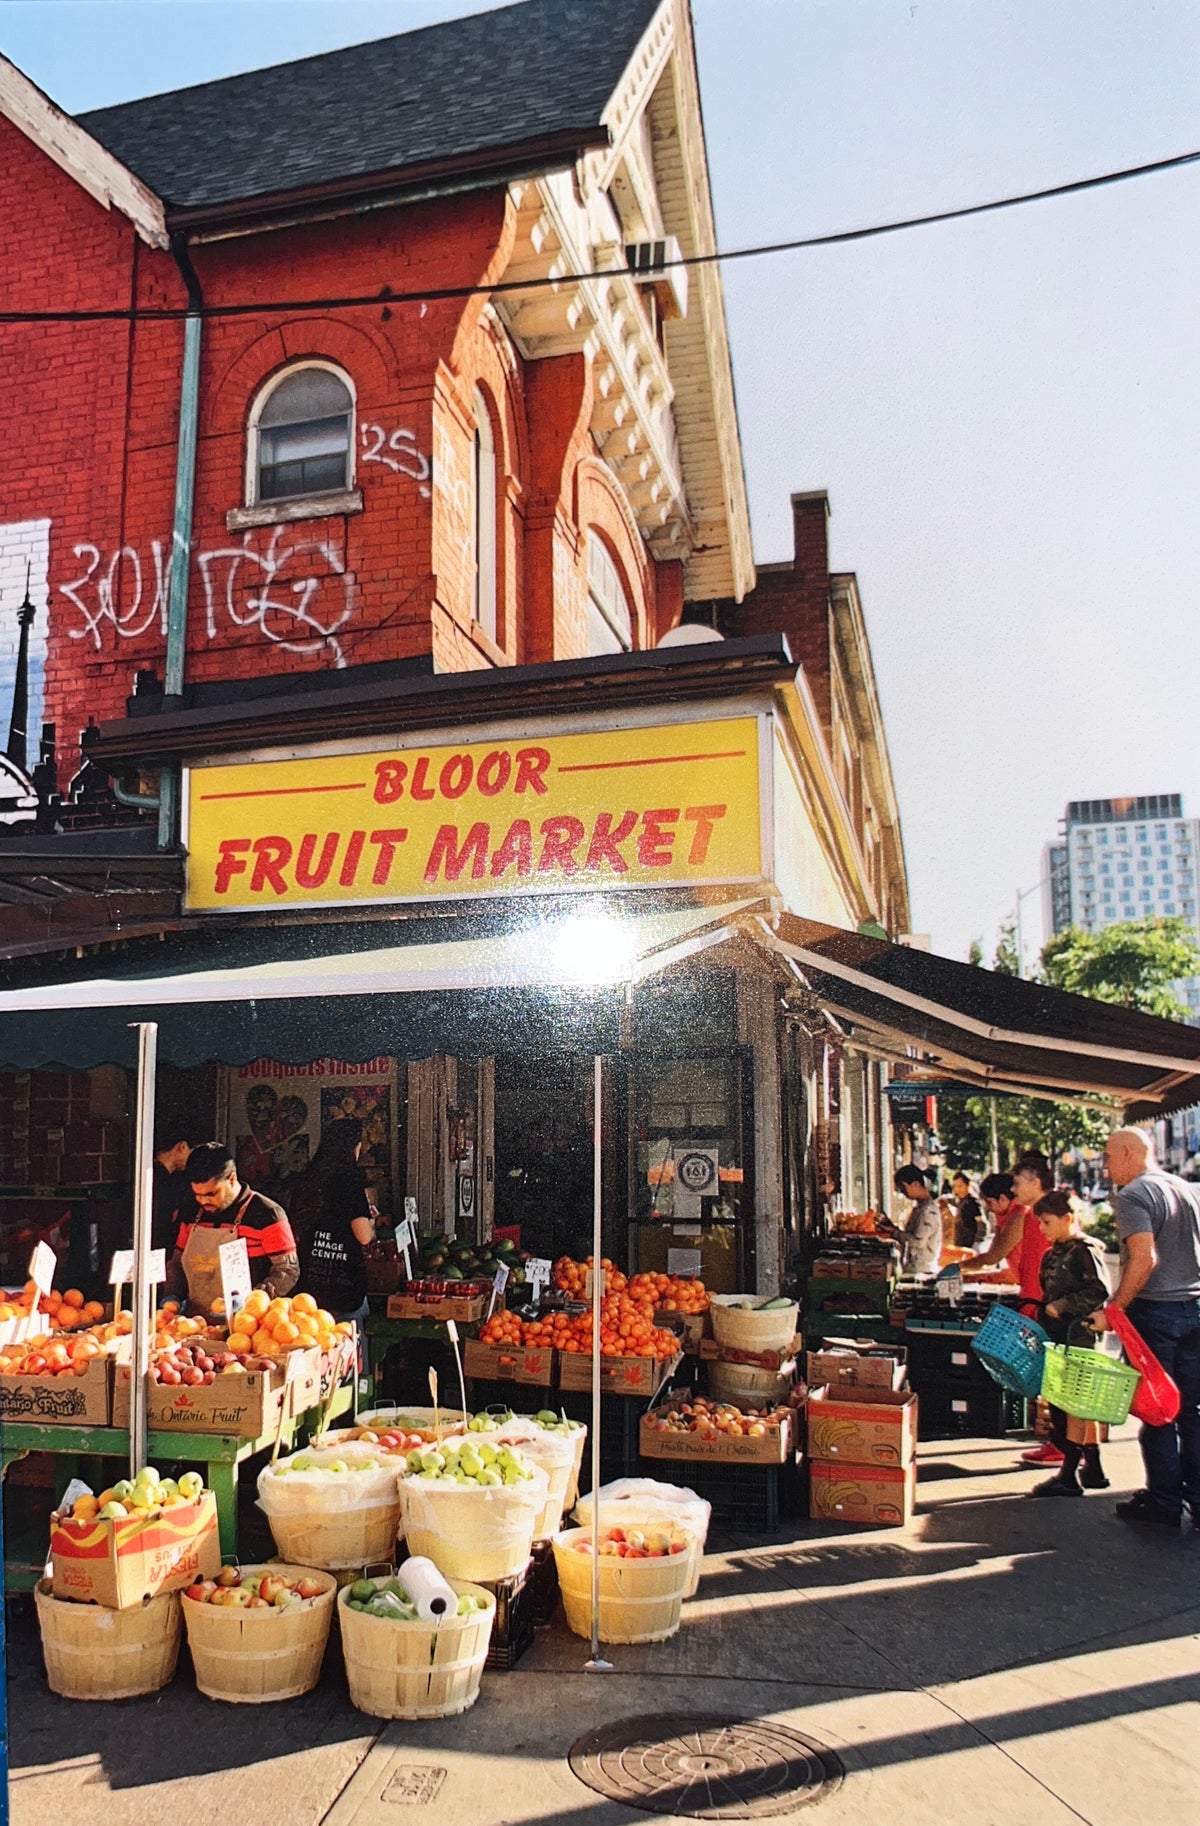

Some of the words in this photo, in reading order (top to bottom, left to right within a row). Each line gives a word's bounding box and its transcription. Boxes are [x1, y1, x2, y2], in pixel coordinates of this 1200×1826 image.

[373, 747, 551, 805] BLOOR
[214, 828, 409, 895] FRUIT
[423, 804, 727, 884] MARKET
[313, 1240, 344, 1251] IMAGE
[311, 1248, 348, 1262] CENTRE
[37, 1396, 74, 1414] Fruit
[161, 1405, 206, 1423] Ontario
[210, 1406, 248, 1424] Fruit
